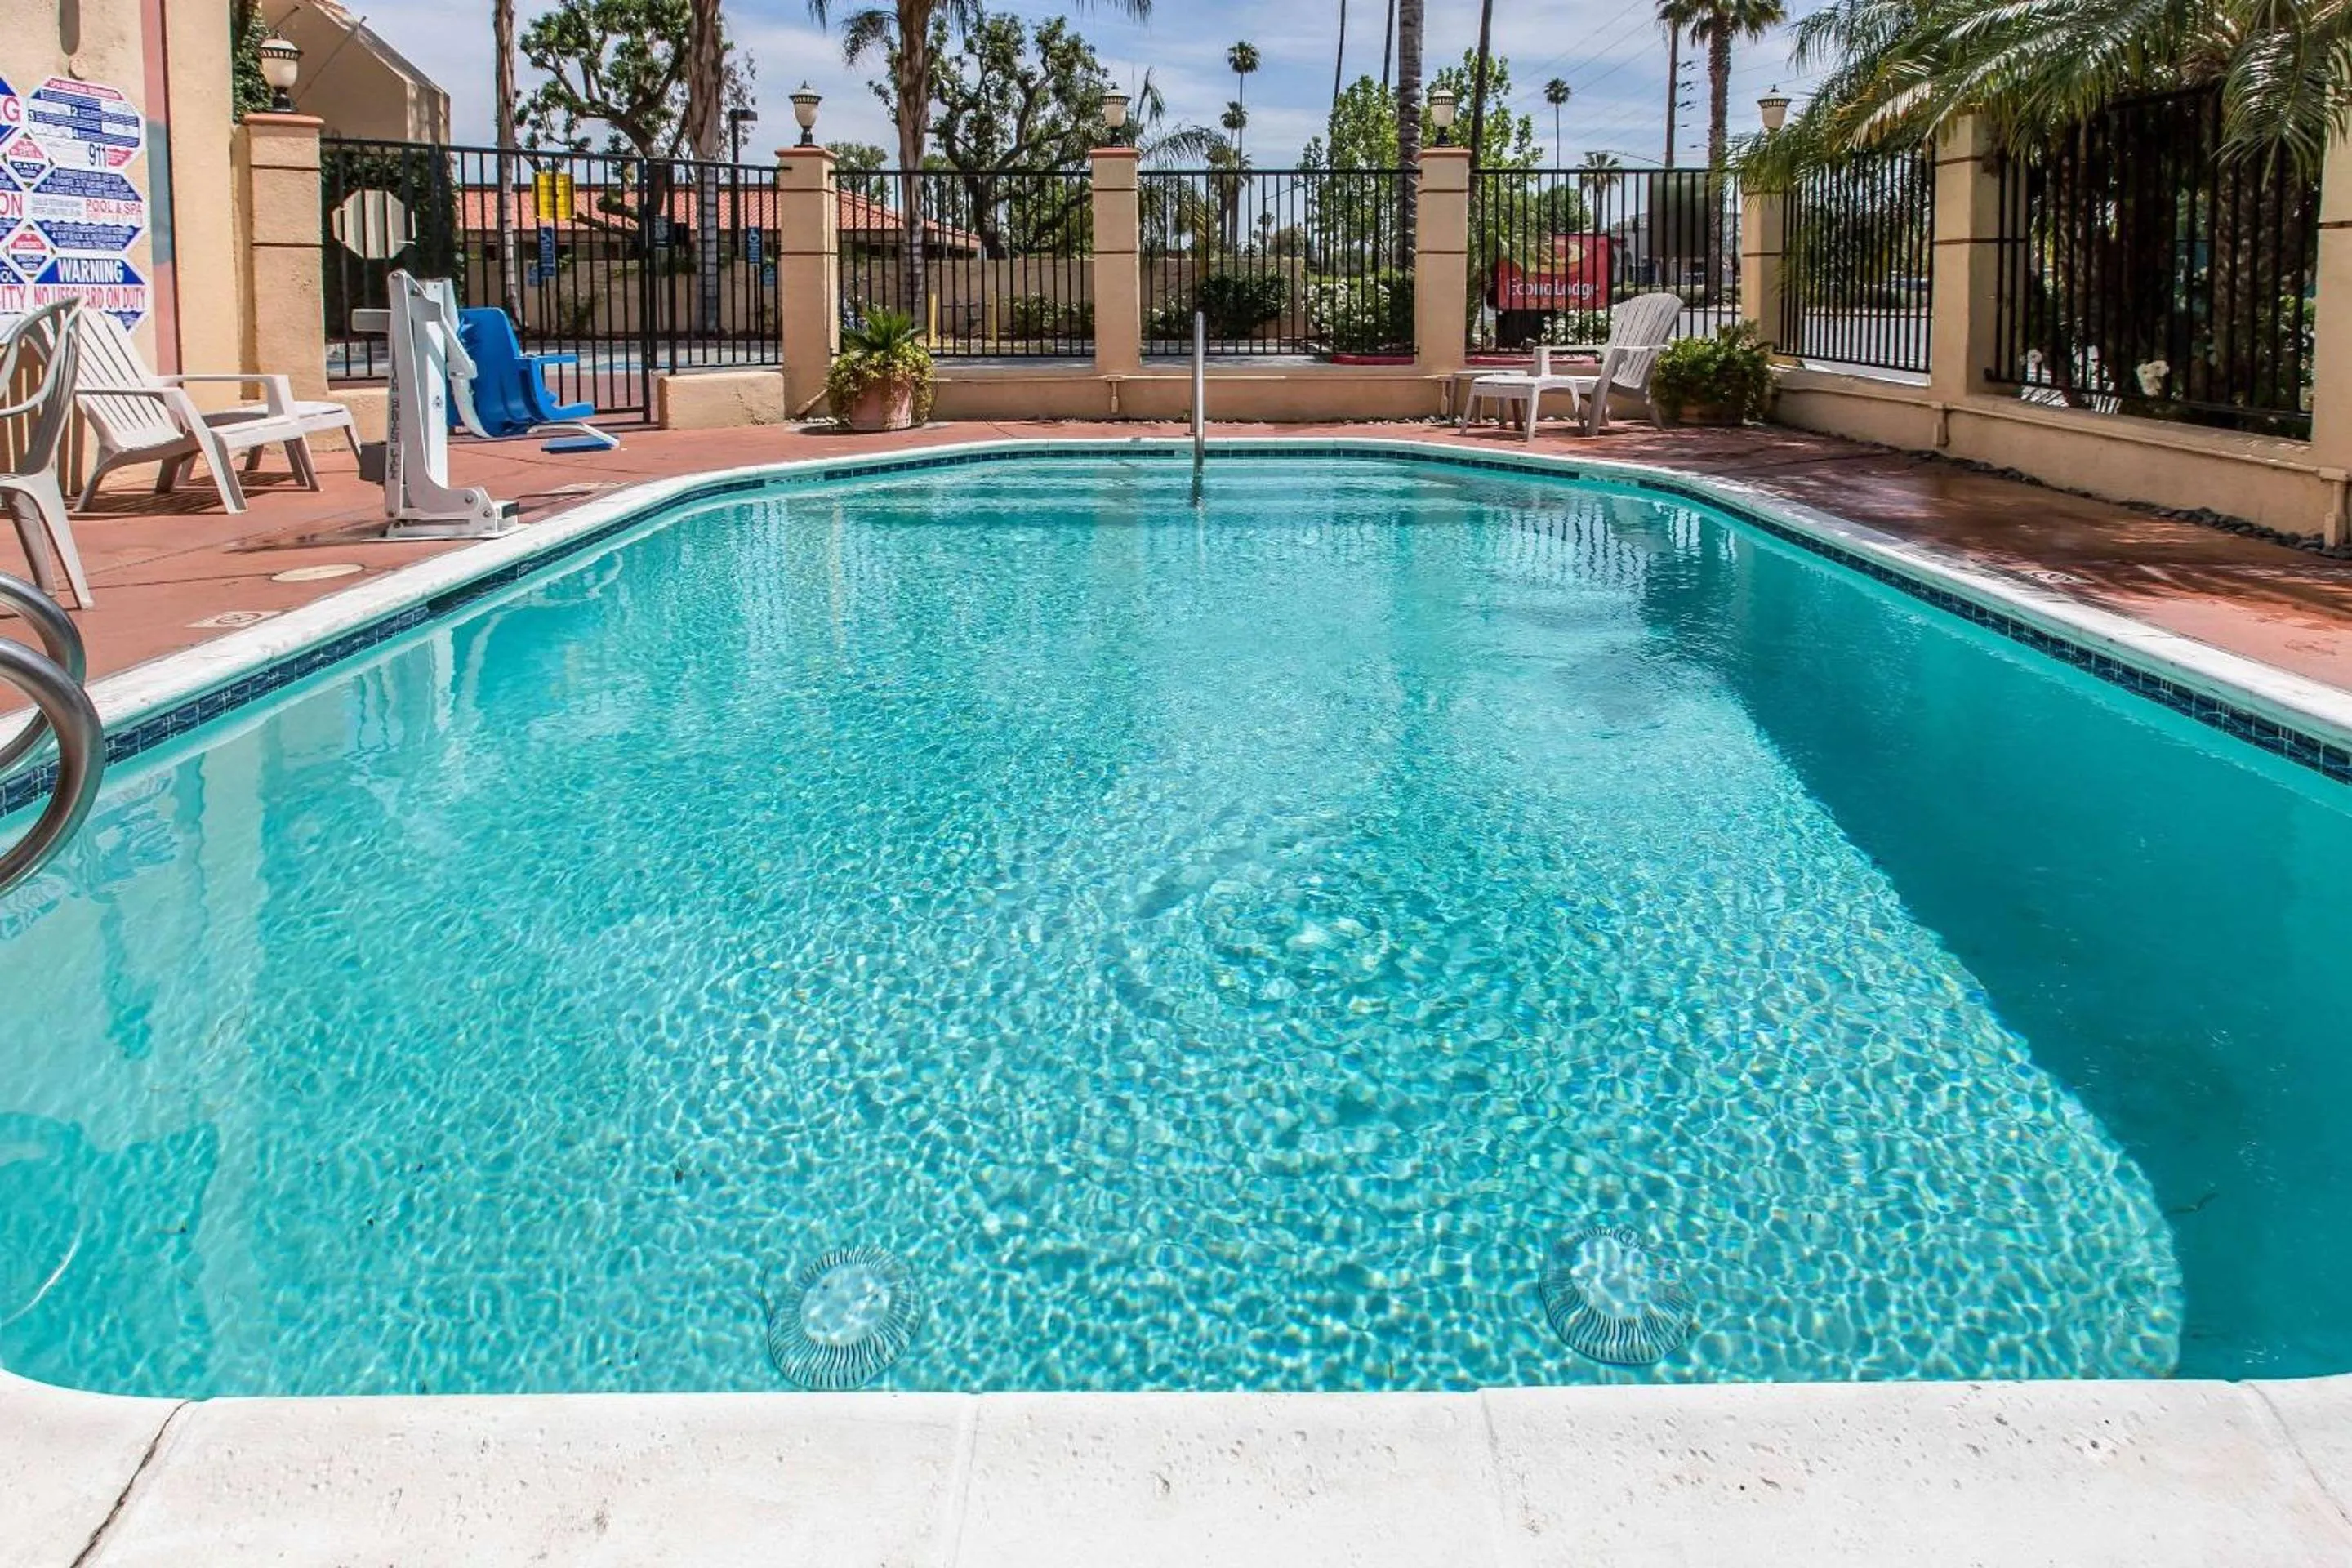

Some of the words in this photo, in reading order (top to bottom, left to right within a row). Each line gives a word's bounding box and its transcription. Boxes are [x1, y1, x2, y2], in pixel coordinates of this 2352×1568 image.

[89, 143, 107, 167] 911
[86, 198, 113, 213] POOL
[123, 202, 142, 216] SPA
[57, 258, 124, 283] WARNING
[107, 287, 120, 308] ON
[123, 287, 145, 309] DUTY
